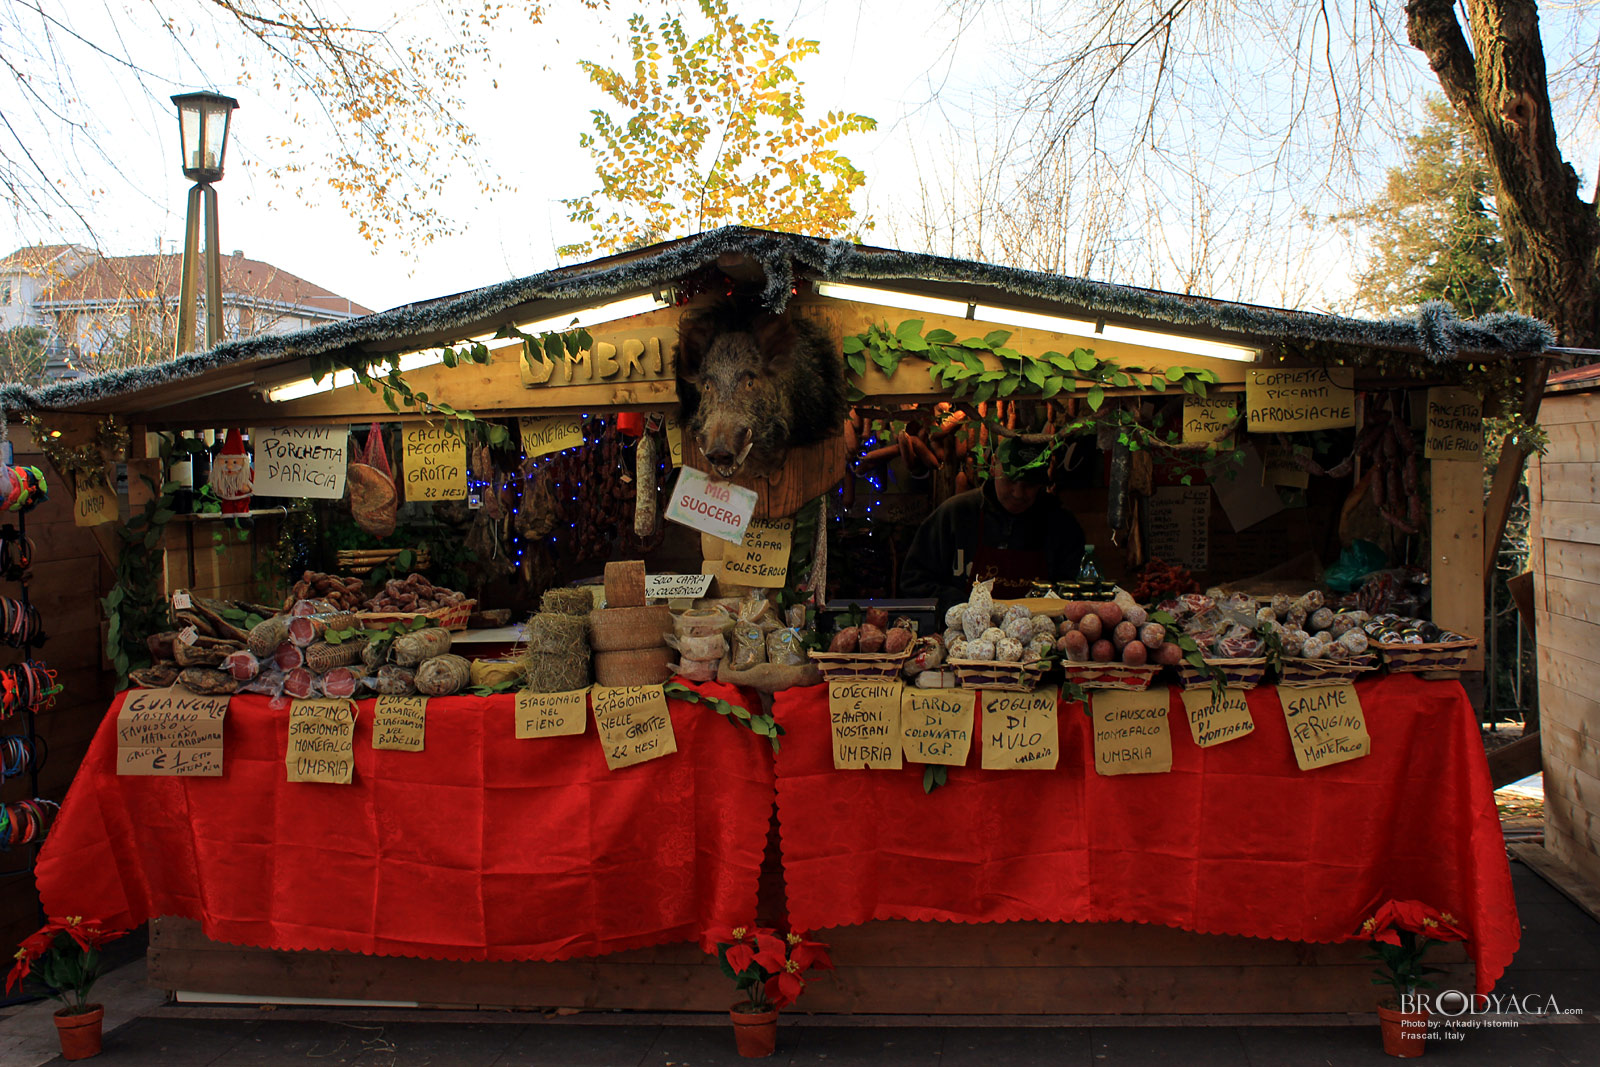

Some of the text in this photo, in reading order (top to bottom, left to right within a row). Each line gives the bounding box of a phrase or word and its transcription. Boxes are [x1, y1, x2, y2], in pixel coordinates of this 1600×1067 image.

[1266, 387, 1328, 401] PICCANTI
[1200, 408, 1216, 420] AL
[1250, 407, 1350, 422] AFRODISIACHE
[1429, 401, 1479, 418] PANCETTA
[1185, 419, 1230, 432] TARTUF
[523, 421, 580, 451] MONTEFALCO
[262, 438, 342, 462] PORCHETTA
[407, 438, 461, 457] PECORA
[424, 455, 435, 465] DI
[268, 462, 337, 490] D'ARICCIA
[408, 464, 458, 483] GROTTA
[424, 486, 466, 498] 22 MESI
[704, 482, 730, 502] MIA
[680, 495, 742, 527] SUOCERA
[745, 531, 763, 540] OLO
[746, 539, 782, 551] CAPRA
[746, 552, 762, 562] NO
[725, 561, 787, 577] COLESTEROLO
[653, 574, 706, 585] SOLO CAPRA
[597, 686, 643, 702] CACIO
[832, 683, 894, 700] COTECHINI
[129, 694, 227, 720] GUANCIALE
[379, 696, 422, 708] LONZA
[520, 693, 580, 710] STAGIONATO
[594, 691, 661, 717] STAGIONATO
[853, 701, 863, 710] E
[911, 696, 961, 713] LARDO
[986, 696, 1054, 713] COGLIONI
[1287, 690, 1346, 717] SALAME
[131, 711, 198, 723] NOSTRANO
[292, 705, 349, 721] LONZINO
[540, 708, 559, 717] NEL
[926, 713, 943, 726] DI
[1104, 707, 1167, 722] CIAUSCOLO
[290, 720, 350, 736] STAGIONATO
[526, 717, 564, 731] FIENO
[601, 713, 633, 731] NELLE
[625, 715, 666, 739] GROTTE
[1007, 711, 1027, 734] DI
[1198, 719, 1210, 733] DI
[1294, 714, 1361, 743] PERUGINO
[120, 722, 178, 742] FAVOLOSO
[386, 727, 403, 736] NEL
[836, 724, 889, 738] NOSTRANI
[904, 728, 967, 741] COLONNATA
[1097, 725, 1161, 741] MONTEFALCO
[295, 736, 352, 752] MONTEFALCO
[379, 733, 420, 747] BUDELLO
[611, 733, 659, 759] 22 MESI
[992, 732, 1042, 750] MULO
[127, 746, 164, 763] GRICIA
[840, 742, 892, 762] UMBRIA
[1102, 746, 1153, 764] UMBRIA
[1303, 735, 1362, 762] MONTEFALCO
[297, 755, 348, 777] UMBRIA
